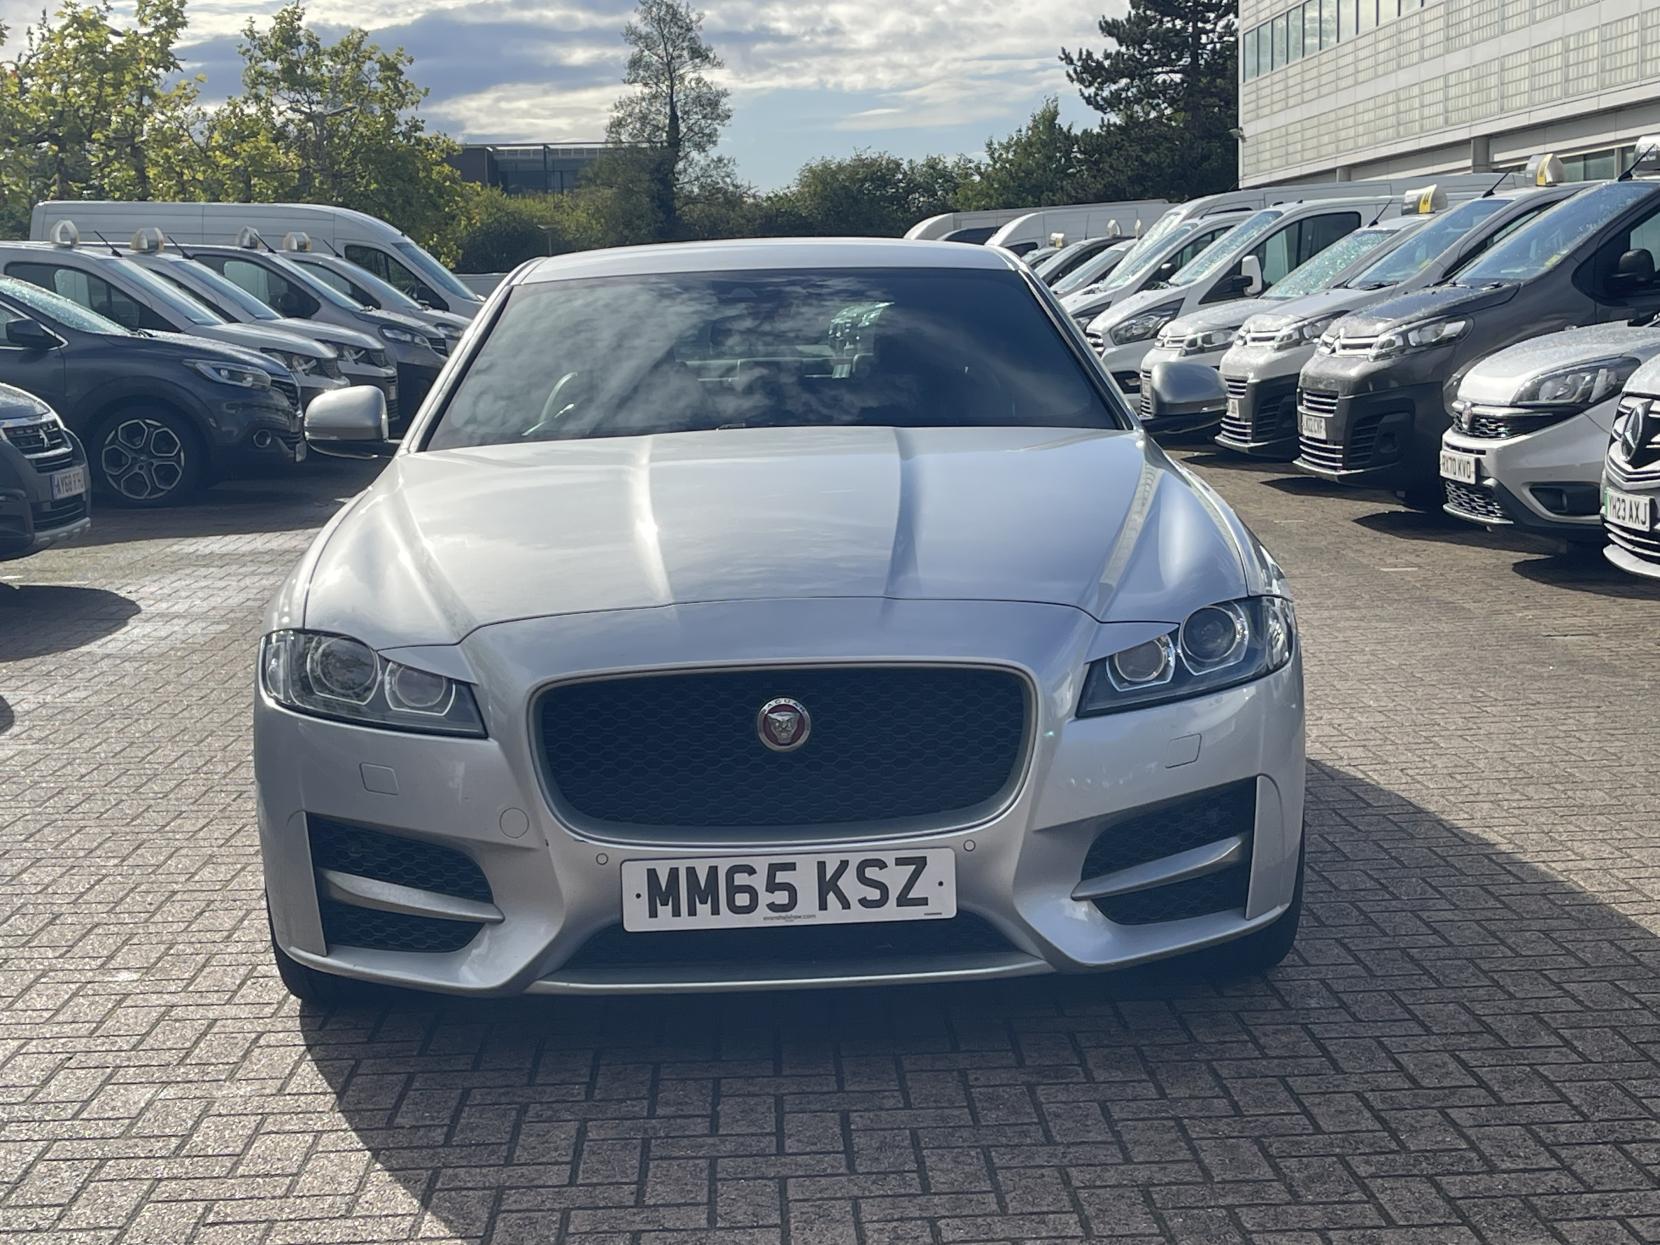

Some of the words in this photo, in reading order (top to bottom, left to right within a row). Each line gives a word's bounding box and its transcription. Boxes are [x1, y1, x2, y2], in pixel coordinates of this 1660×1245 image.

[1628, 500, 1648, 526] AXJ
[759, 698, 805, 716] JAGUAR
[646, 863, 798, 919] MM65
[817, 856, 929, 911] KSZ
